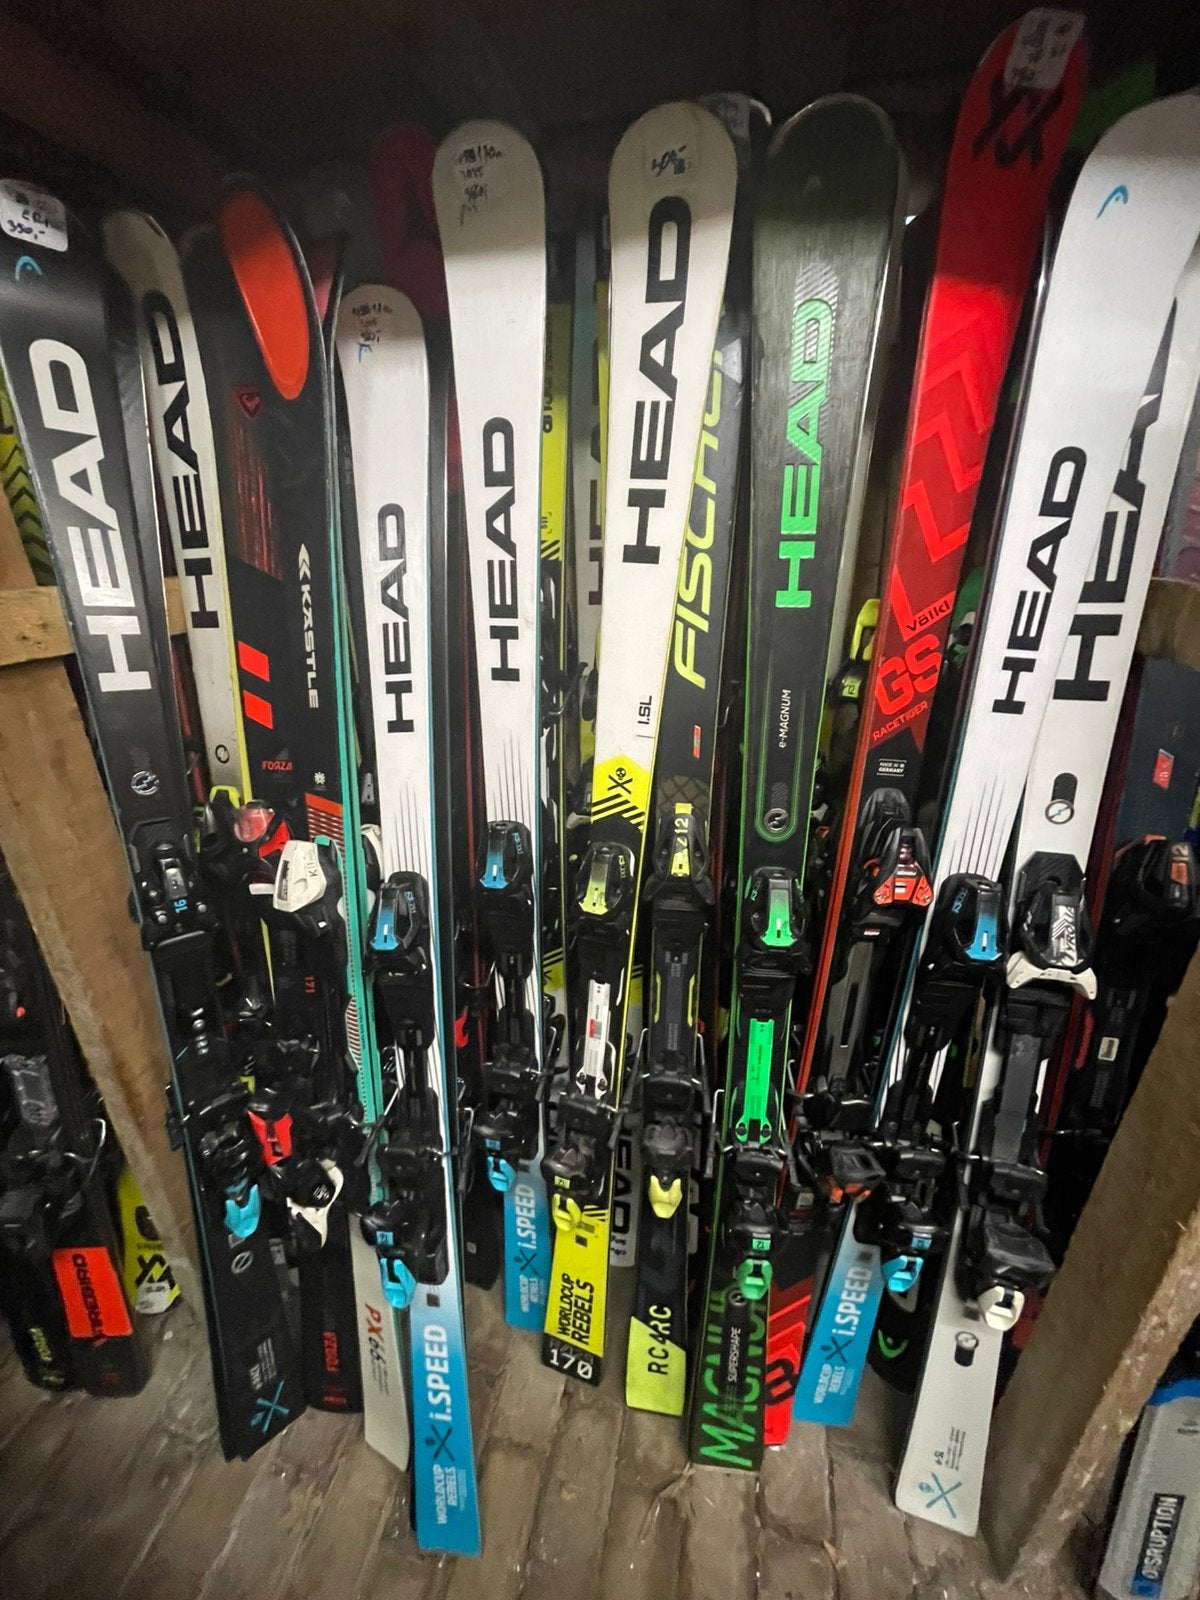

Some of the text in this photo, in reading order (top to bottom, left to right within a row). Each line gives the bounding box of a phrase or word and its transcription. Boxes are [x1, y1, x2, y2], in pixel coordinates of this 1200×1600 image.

[623, 196, 692, 564] HEAD
[142, 289, 220, 629] HEAD
[776, 298, 836, 608] HEAD
[29, 338, 152, 692] HEAD
[1052, 297, 1177, 701] HEA
[482, 416, 520, 682] HEAD
[993, 446, 1088, 715] HEAD
[378, 503, 415, 733] HEAD
[875, 634, 942, 715] GS
[778, 689, 792, 749] e-MAGNUM
[872, 700, 929, 741] RACETIGER
[261, 760, 294, 771] FORZA
[515, 1184, 537, 1250] i.SPEED
[557, 1272, 575, 1336] WORLDCUP
[571, 1278, 595, 1346] REBELS
[832, 1266, 873, 1337] i.SPEED
[424, 1324, 453, 1422] i.SPEED
[550, 1348, 593, 1380] 170
[727, 1326, 742, 1383] SUPERSHAPE
[1141, 1496, 1178, 1580] DISRUPTION
